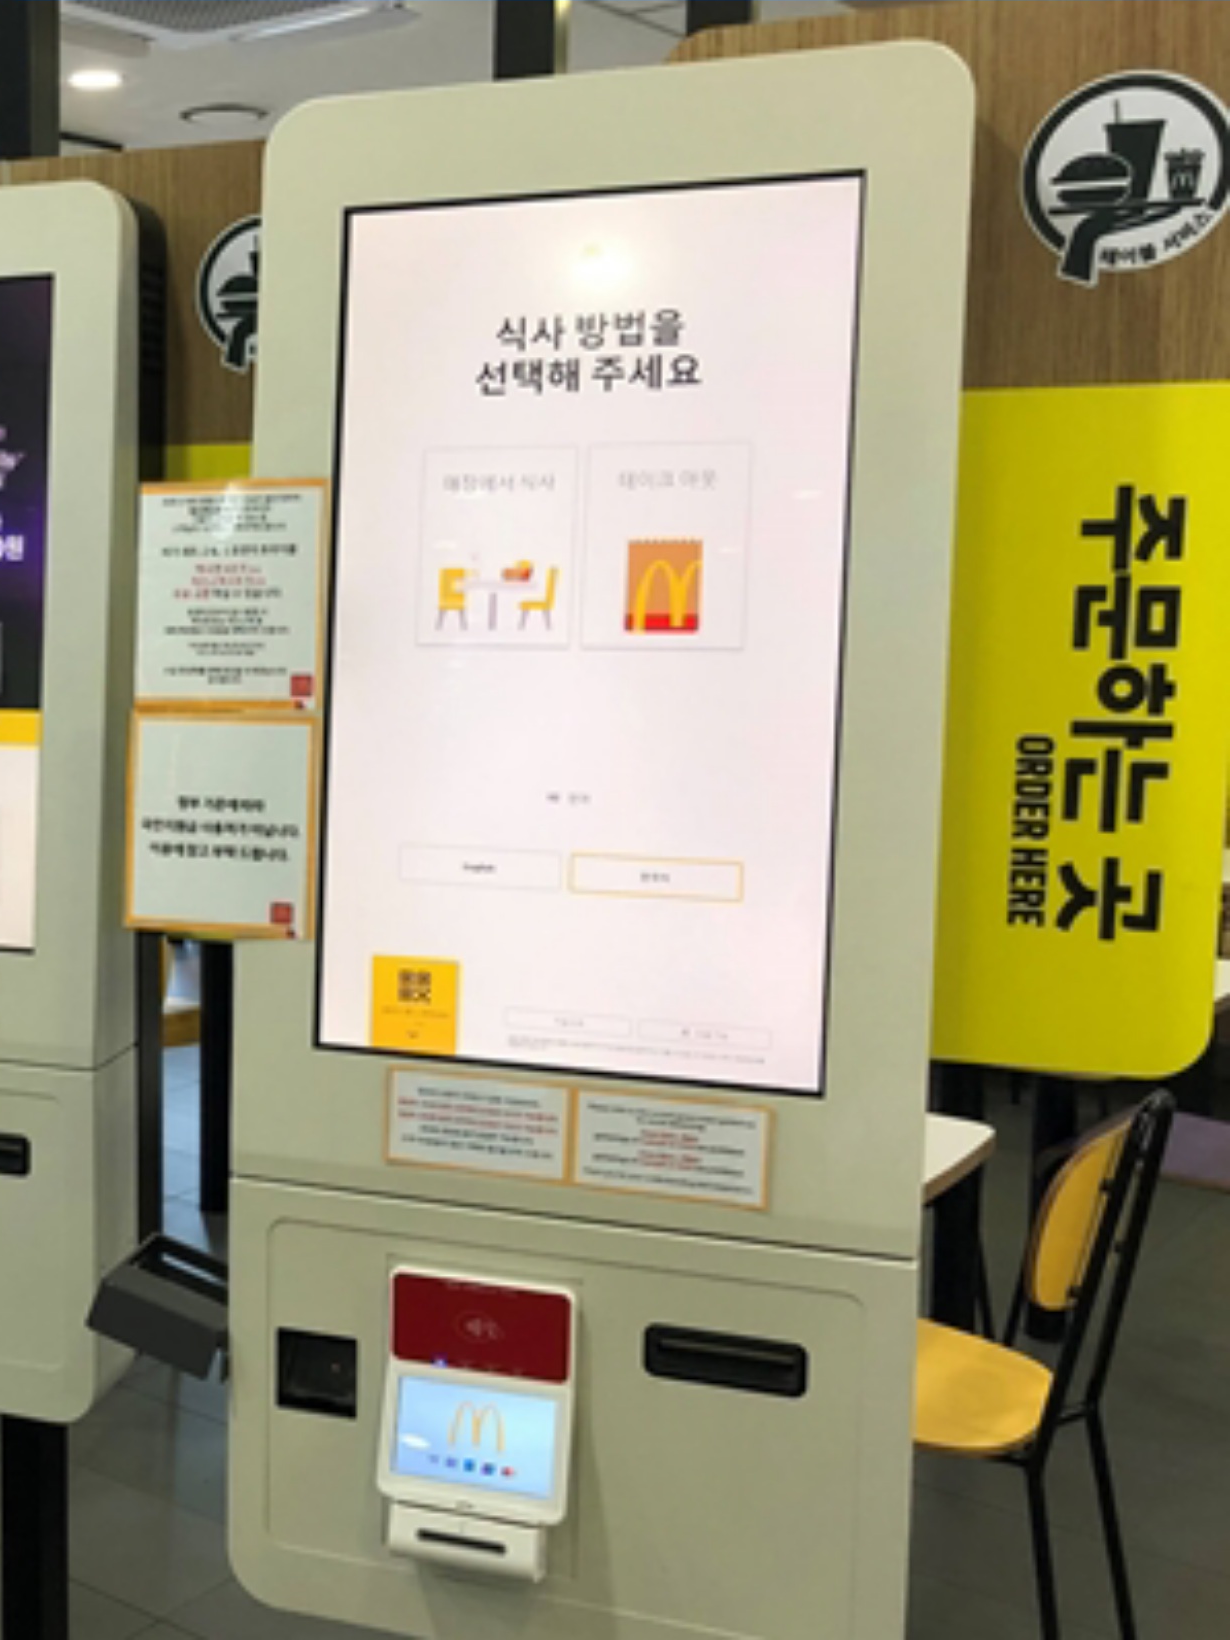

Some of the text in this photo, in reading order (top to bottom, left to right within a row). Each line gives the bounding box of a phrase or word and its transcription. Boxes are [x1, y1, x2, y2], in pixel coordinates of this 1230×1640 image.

[476, 354, 701, 396] 선택해 주세요
[497, 309, 685, 351] 식사 방법을
[1055, 484, 1186, 940] 주문하는 곳
[1007, 735, 1054, 927] ORDER HERE
